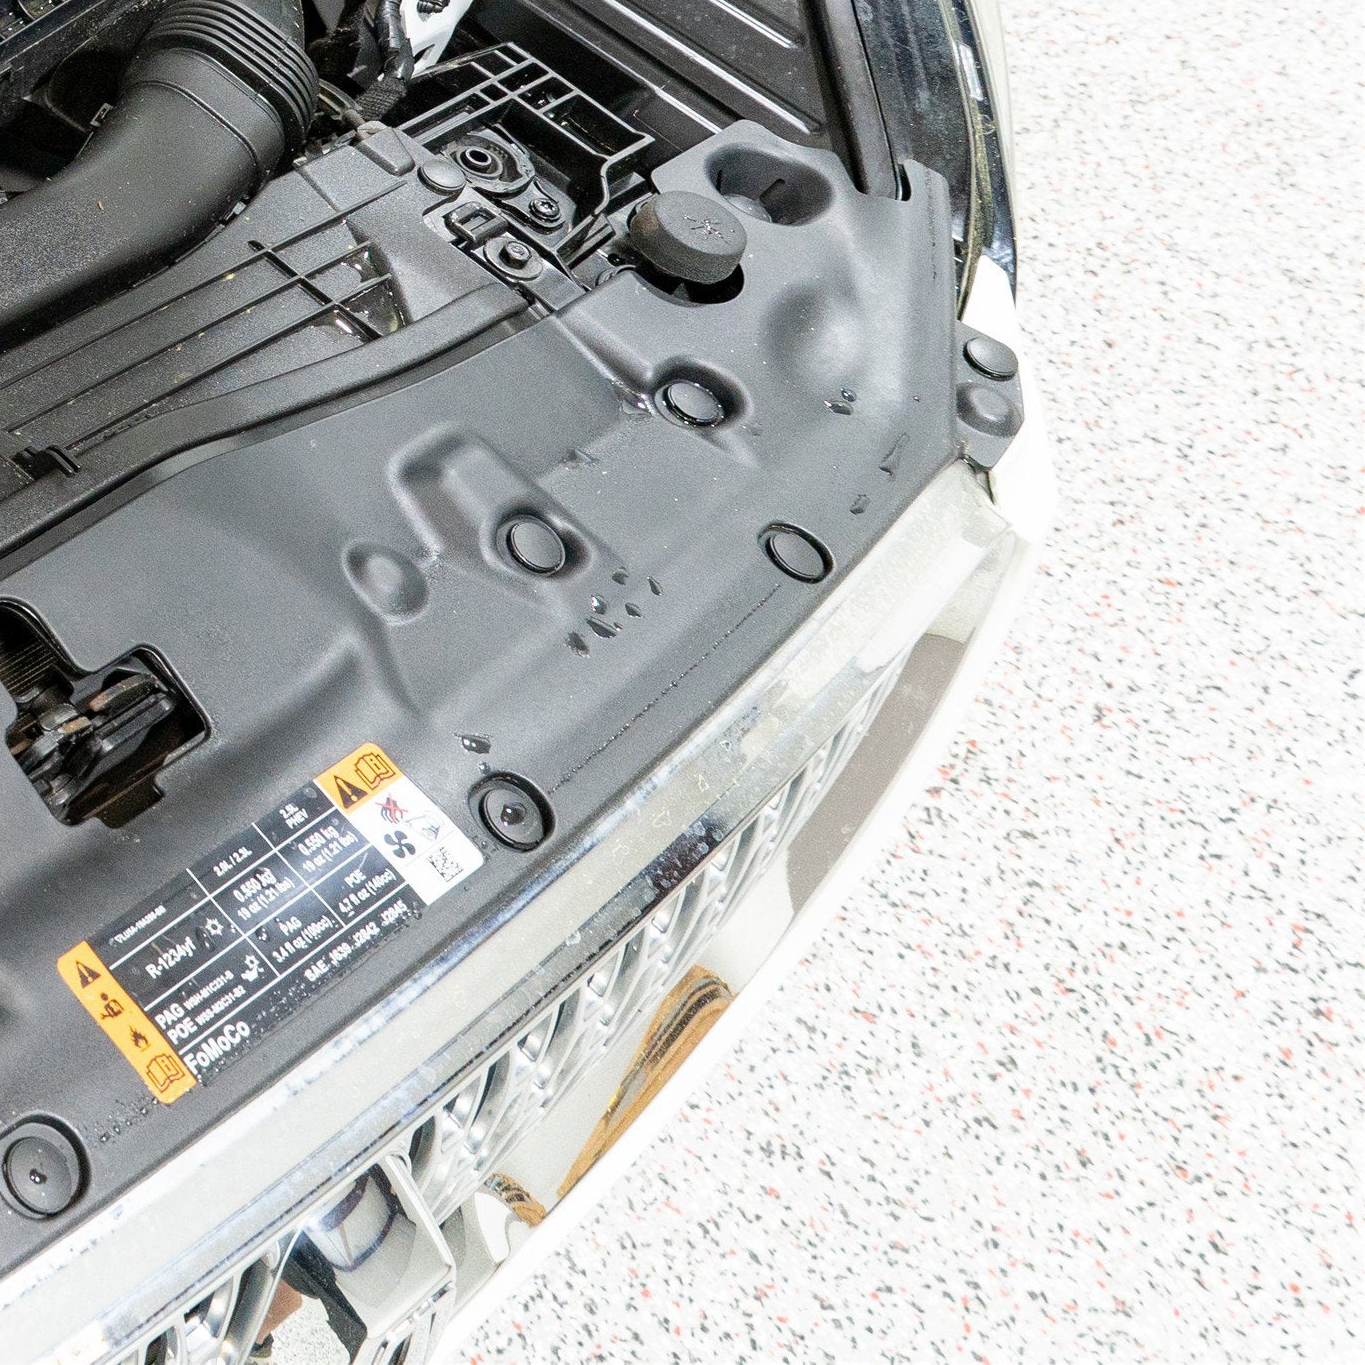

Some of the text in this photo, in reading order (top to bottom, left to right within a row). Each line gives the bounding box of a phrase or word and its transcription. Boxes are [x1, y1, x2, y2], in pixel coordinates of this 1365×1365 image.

[286, 809, 308, 829] PHEV
[297, 825, 339, 856] 0.550 kg
[323, 838, 342, 862] (1.21
[233, 868, 277, 903] 0.550 kg
[344, 869, 367, 888] POE
[358, 885, 371, 900] oz
[367, 868, 397, 896] (140cc)
[237, 877, 295, 920] 19 oz (1.21 lbs)
[279, 916, 302, 936] PAG
[145, 936, 196, 980] R-1234yf
[272, 947, 288, 963] 3.4
[155, 1003, 185, 1030] PAG
[167, 1018, 197, 1045] POE
[183, 1021, 250, 1074] FoMoCo
